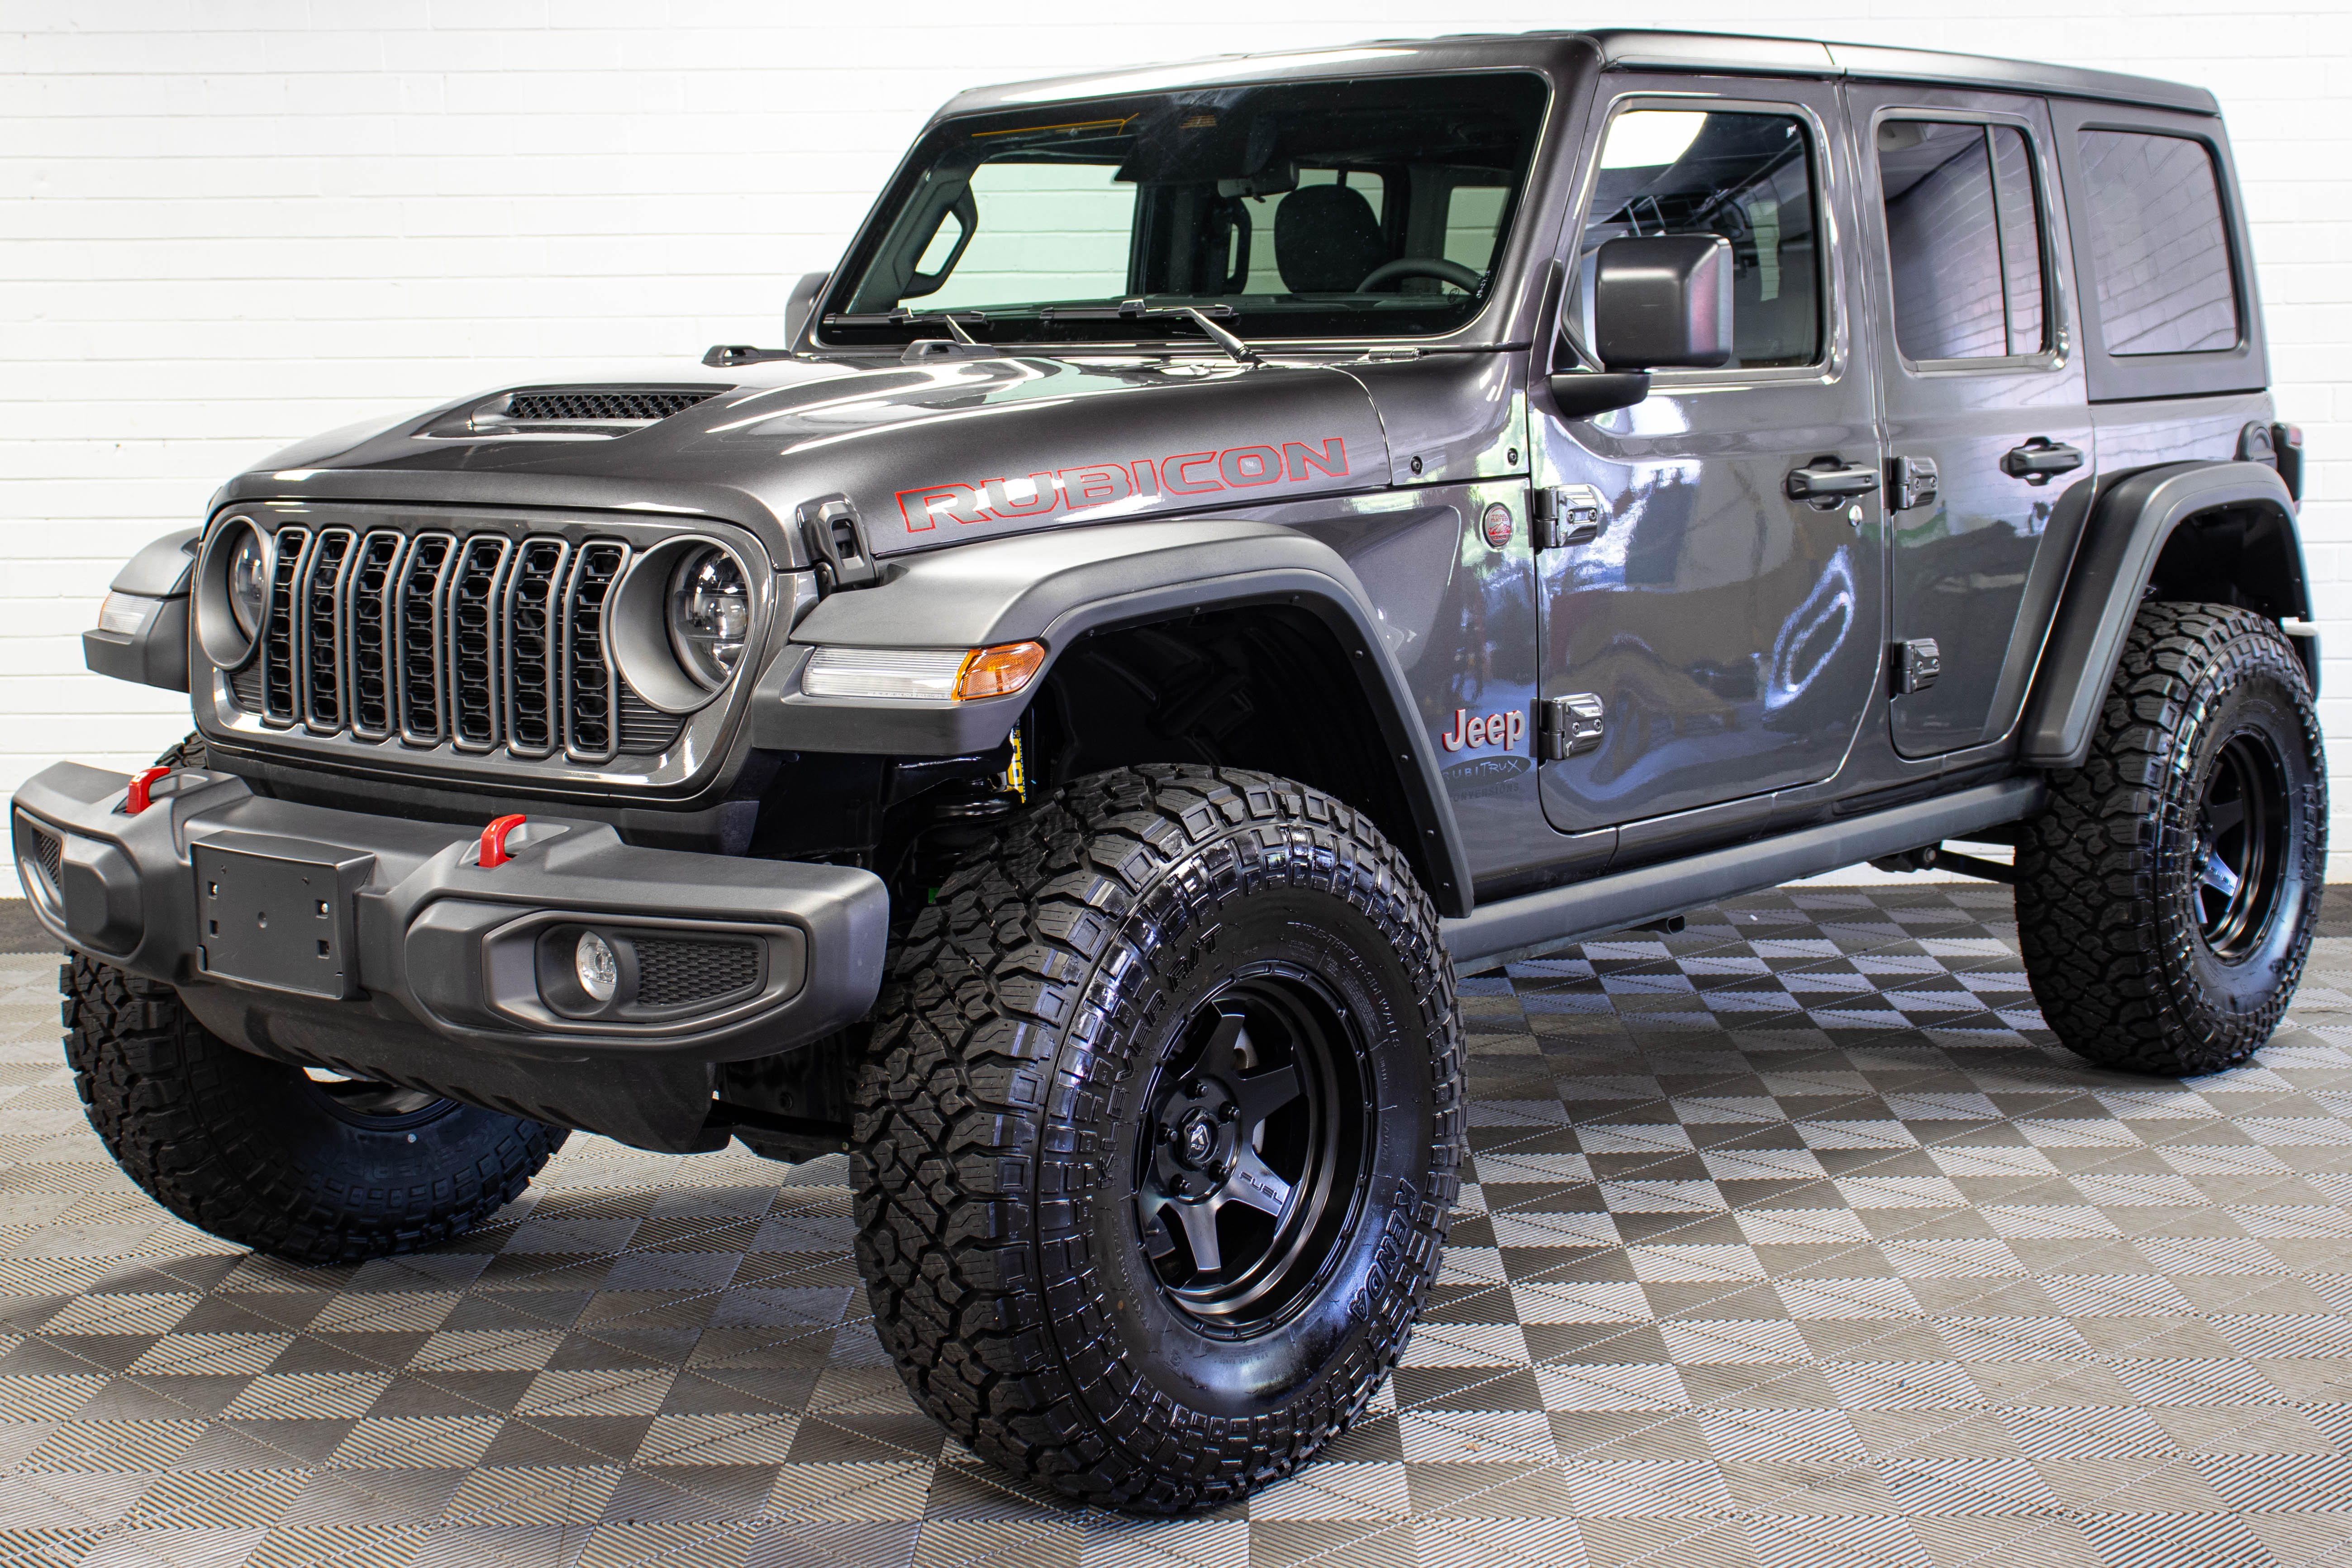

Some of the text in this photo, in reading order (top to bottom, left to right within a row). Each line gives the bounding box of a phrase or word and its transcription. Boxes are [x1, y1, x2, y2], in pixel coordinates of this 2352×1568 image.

[895, 437, 1349, 533] RUBICON
[1442, 709, 1525, 752] Jeep
[2301, 783, 2317, 879] KENDA
[2209, 866, 2235, 890] FUEL
[1238, 1171, 1283, 1206] FUEL
[1347, 1177, 1417, 1323] KENDA
